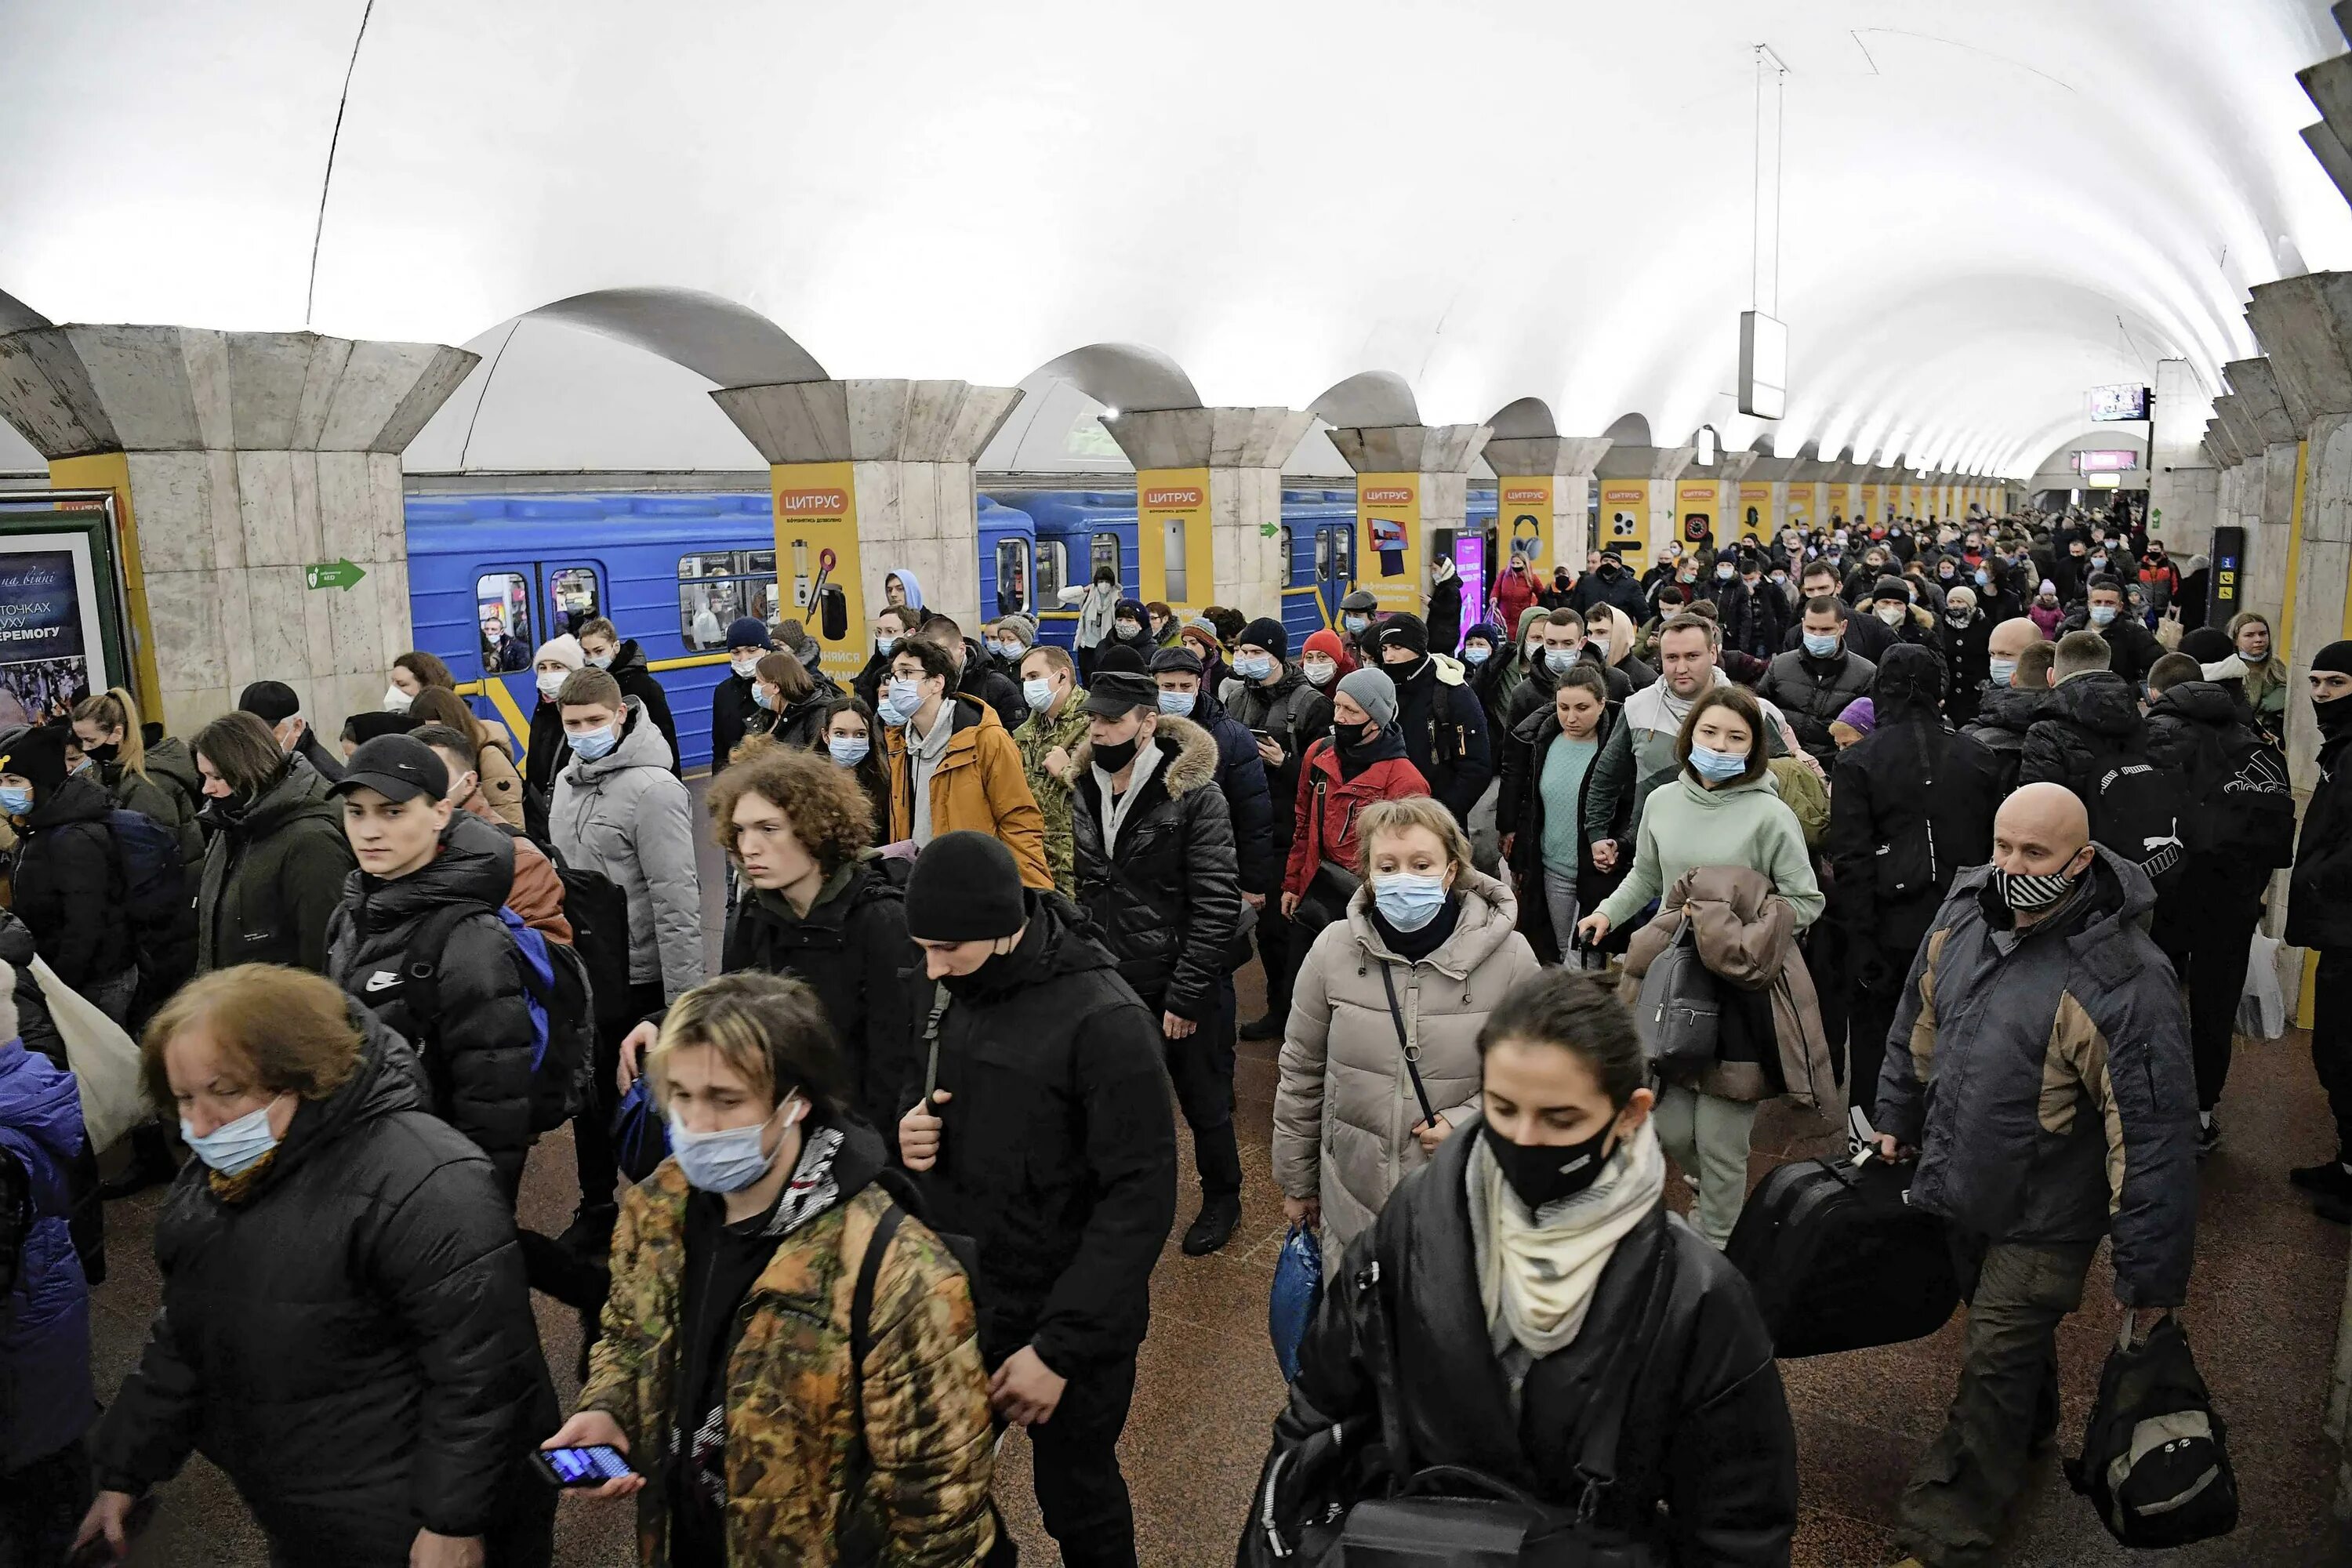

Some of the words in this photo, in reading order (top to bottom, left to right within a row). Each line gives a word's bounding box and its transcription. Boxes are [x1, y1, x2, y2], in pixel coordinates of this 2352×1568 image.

[1148, 492, 1197, 504] ЦИТРУС
[1367, 491, 1408, 500] ЦИТРУС
[785, 495, 840, 510] ЦИТРУС
